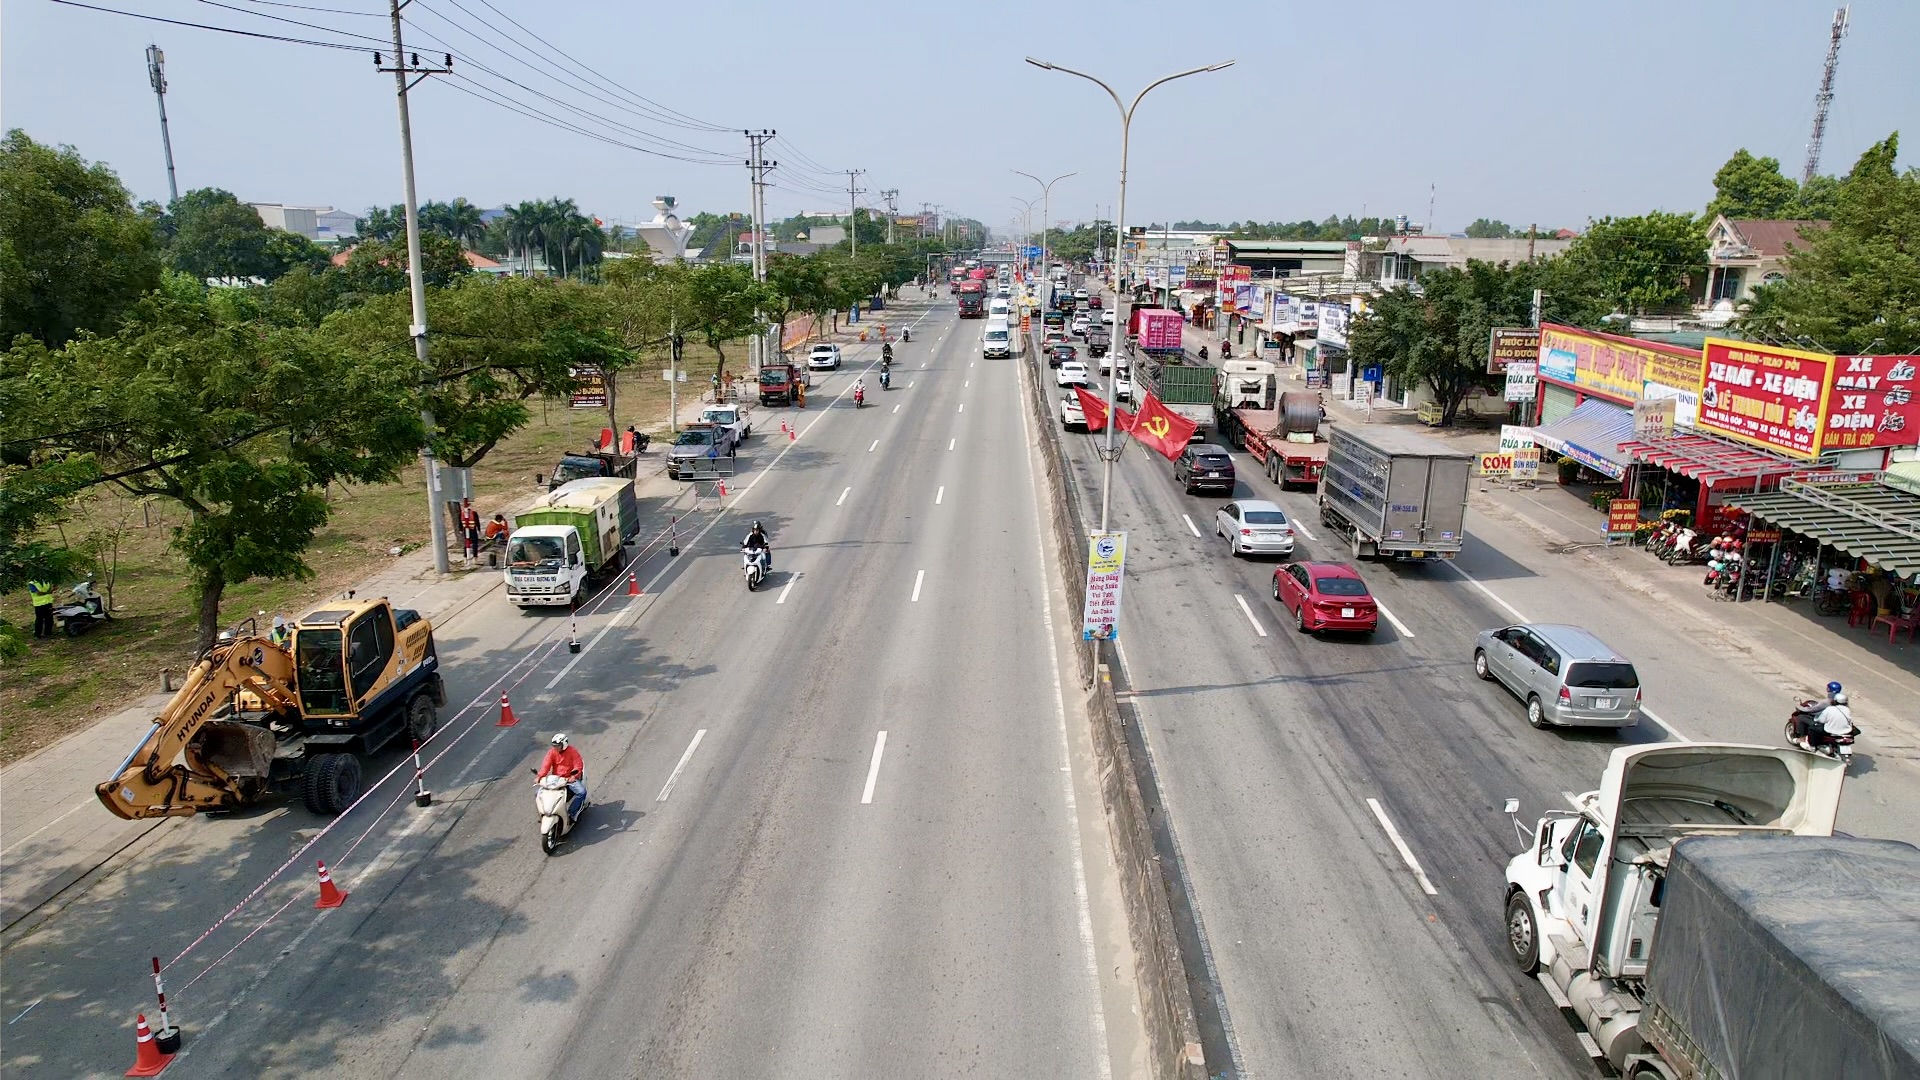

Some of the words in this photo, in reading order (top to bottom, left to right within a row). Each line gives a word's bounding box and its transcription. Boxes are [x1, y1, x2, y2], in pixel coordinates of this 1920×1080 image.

[1500, 336, 1523, 346] PHÚC
[1525, 337, 1539, 346] LÂ
[1847, 358, 1873, 372] XE
[1525, 374, 1536, 384] XE
[1708, 362, 1726, 382] XE
[1725, 364, 1756, 387] MÁY
[1762, 372, 1783, 394] XE
[1783, 375, 1820, 403] ĐIỆN
[1836, 374, 1881, 390] MÁY
[1718, 389, 1731, 411] LÊ
[1788, 408, 1798, 428] 5
[1841, 395, 1867, 409] XE
[1830, 411, 1875, 431] ĐIỆN
[1747, 420, 1759, 431] THU
[1760, 423, 1769, 433] XE
[1794, 432, 1809, 444] CAO
[1824, 431, 1839, 446] BÁN
[1843, 431, 1856, 446] TRẢ
[1860, 431, 1875, 446] GÓP
[1482, 454, 1512, 469] CƠM
[1612, 502, 1622, 510] SỬA
[177, 691, 216, 742] HYUNDAI
